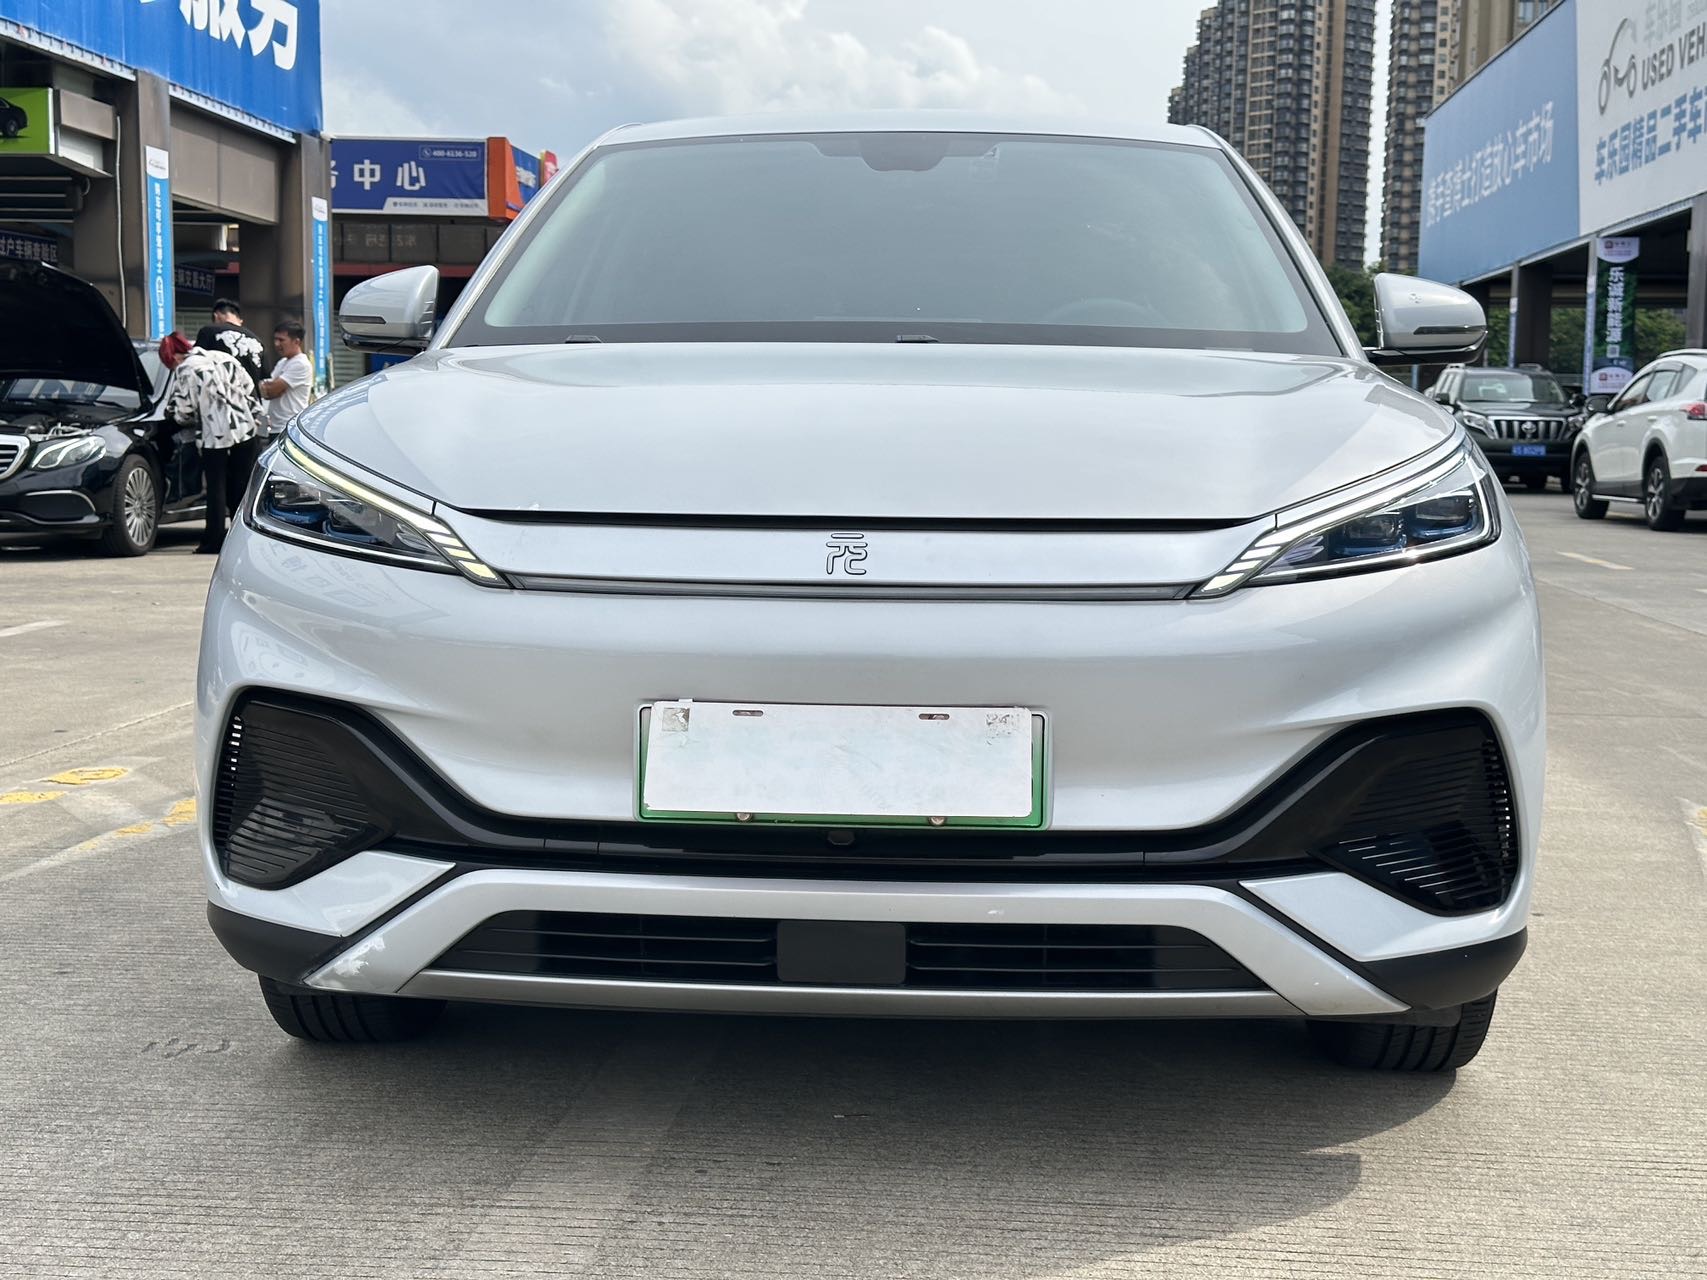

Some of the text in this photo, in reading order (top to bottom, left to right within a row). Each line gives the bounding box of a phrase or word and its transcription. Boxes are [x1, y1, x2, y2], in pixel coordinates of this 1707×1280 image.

[1642, 21, 1707, 91] USED VEH
[1594, 85, 1707, 186] 车乐园精品二手车
[175, 268, 215, 291] 辆交易大厅
